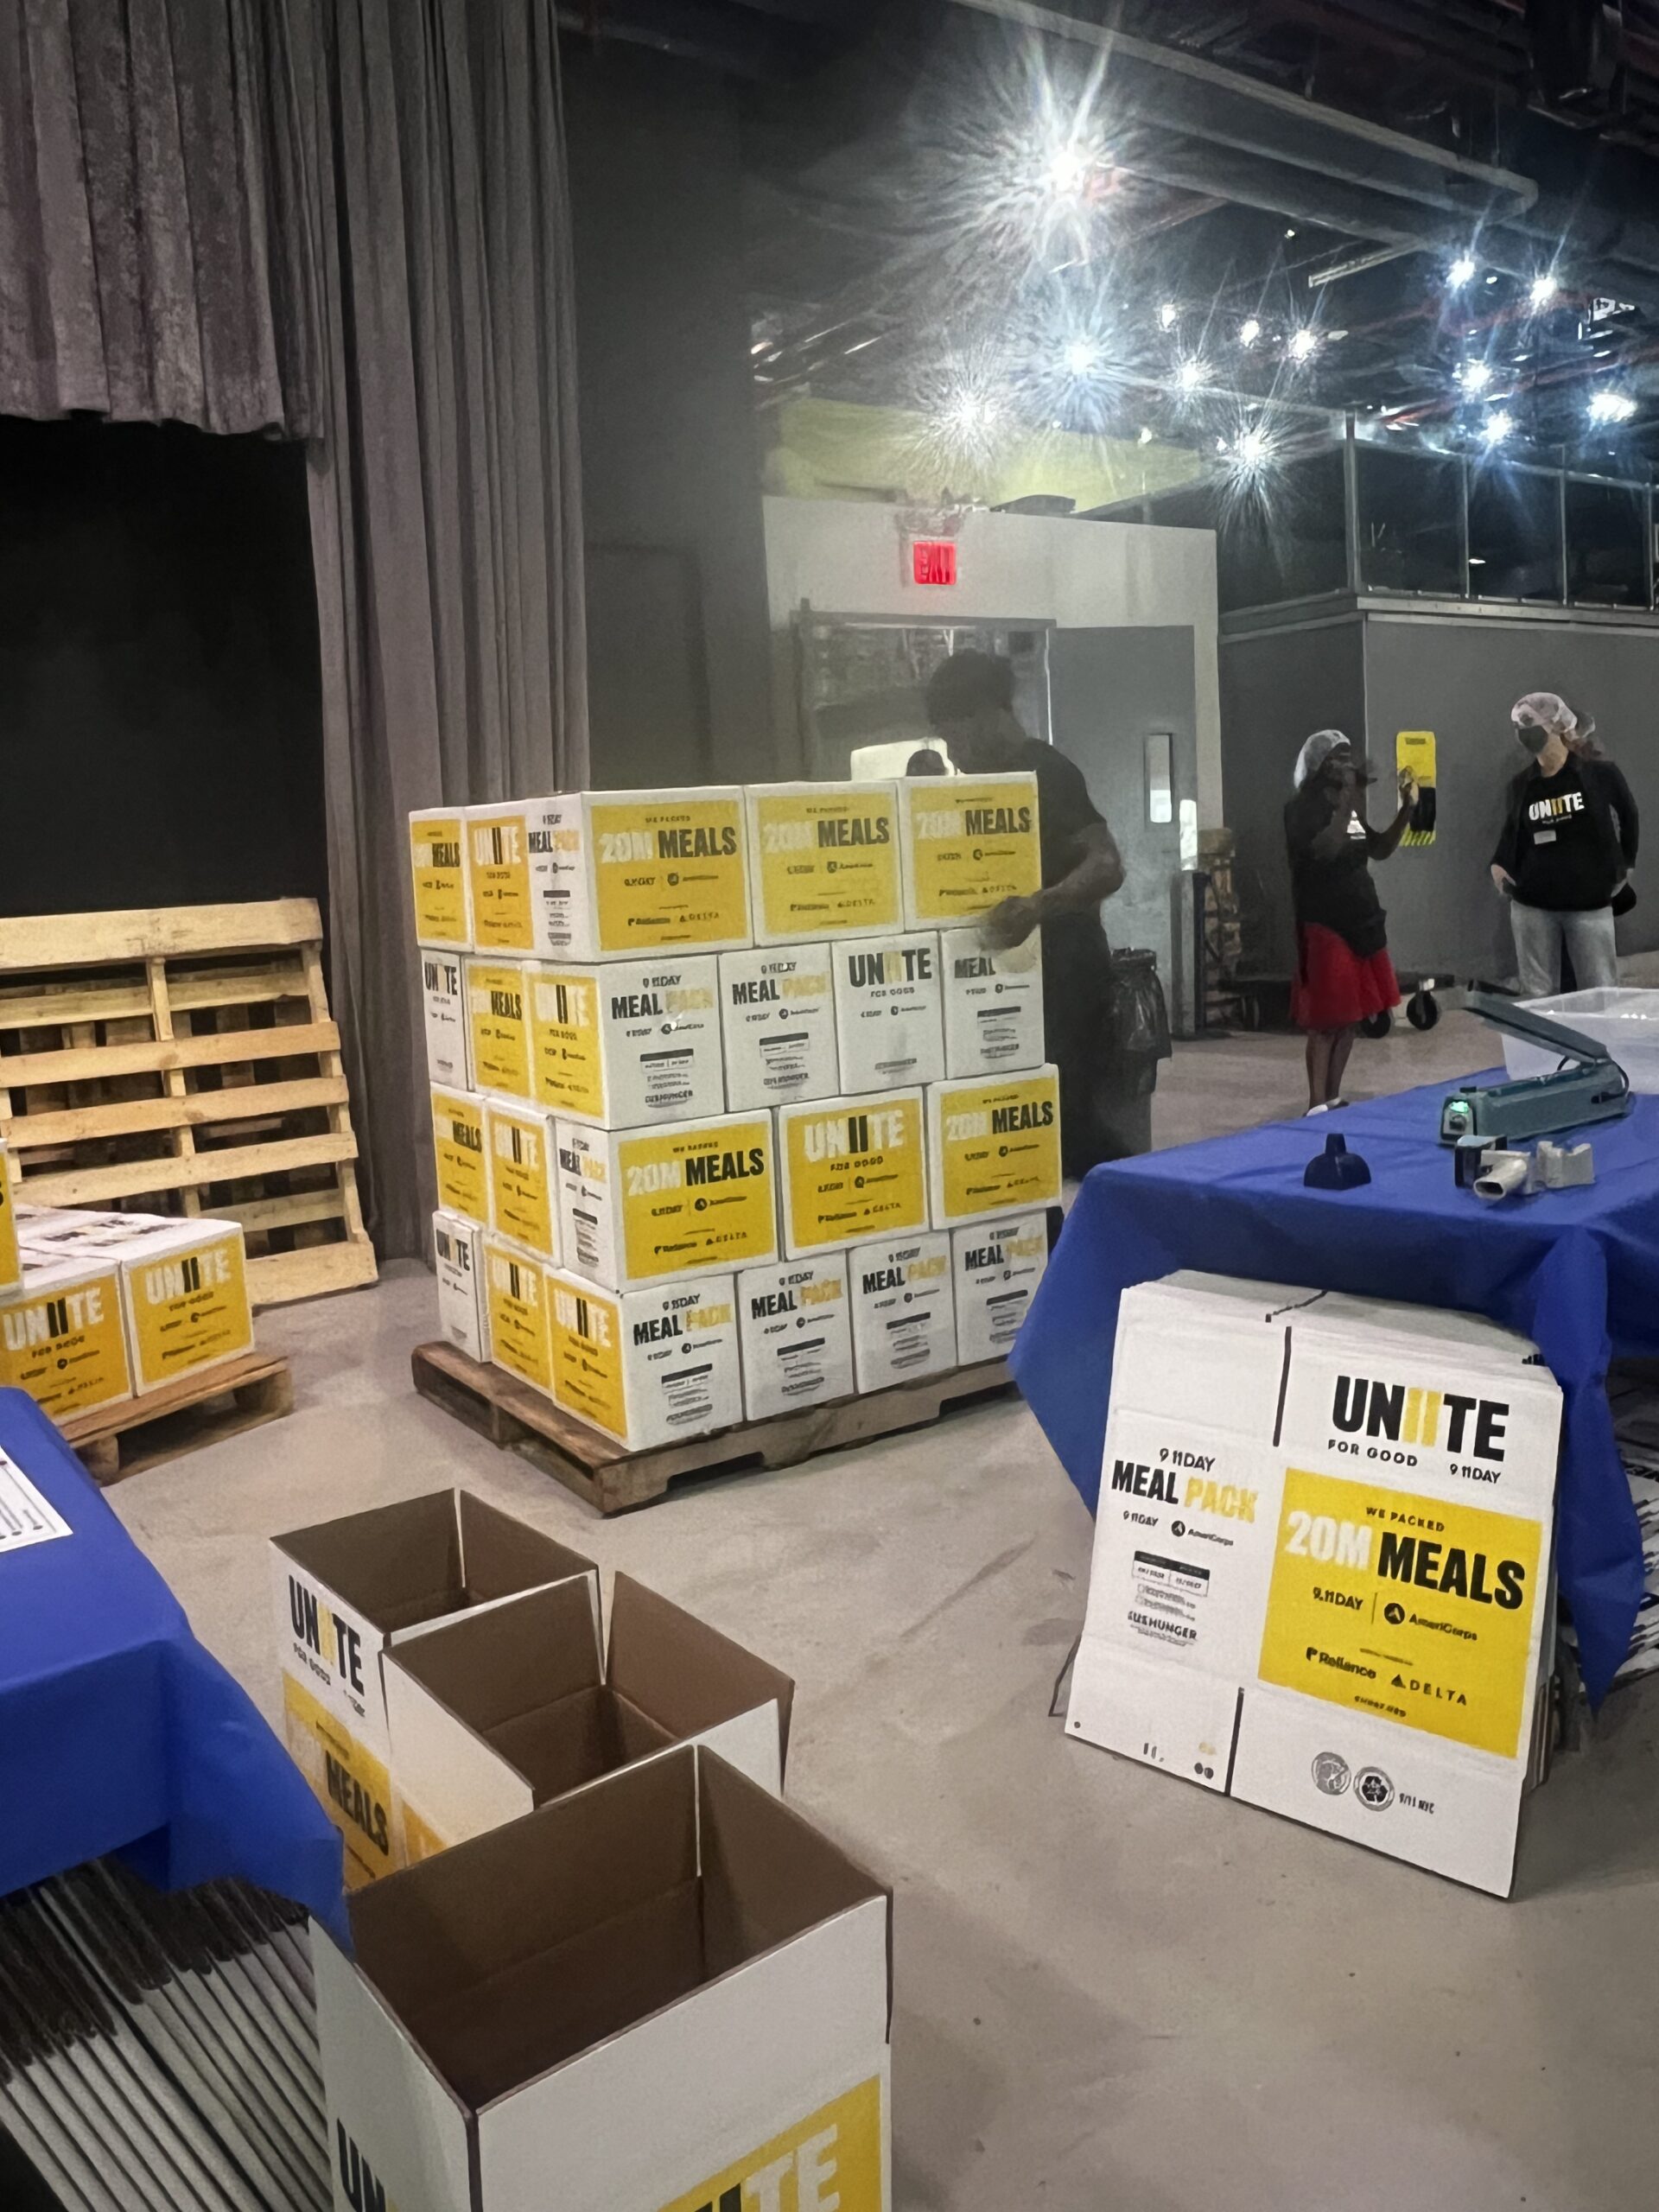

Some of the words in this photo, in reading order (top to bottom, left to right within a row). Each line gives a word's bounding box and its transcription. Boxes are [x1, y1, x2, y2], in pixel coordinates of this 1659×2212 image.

[818, 817, 890, 848] MEALS
[965, 806, 1031, 836] MEALS
[658, 827, 737, 858] MEALS
[955, 957, 995, 978] MEAL
[491, 990, 522, 1020] MEALS
[612, 994, 663, 1020] MEAL
[733, 979, 779, 1005] MEAL
[992, 1101, 1053, 1135] MEALS
[685, 1147, 765, 1186] MEALS
[965, 1244, 1004, 1271] MEAL
[863, 1267, 906, 1294] MEAL
[751, 1290, 798, 1319] MEAL
[633, 1314, 683, 1346] MEAL
[1328, 1439, 1359, 1455] FOR
[1367, 1447, 1418, 1466] GOOD
[1111, 1459, 1179, 1504] MEAL
[1185, 1477, 1258, 1523] PACK
[1366, 1507, 1385, 1518] WE
[1390, 1511, 1445, 1532] PACKED
[1284, 1510, 1373, 1571] 20M
[1377, 1531, 1525, 1610] MEALS
[1410, 1680, 1467, 1707] DELTA
[326, 1749, 389, 1857] MEALS
